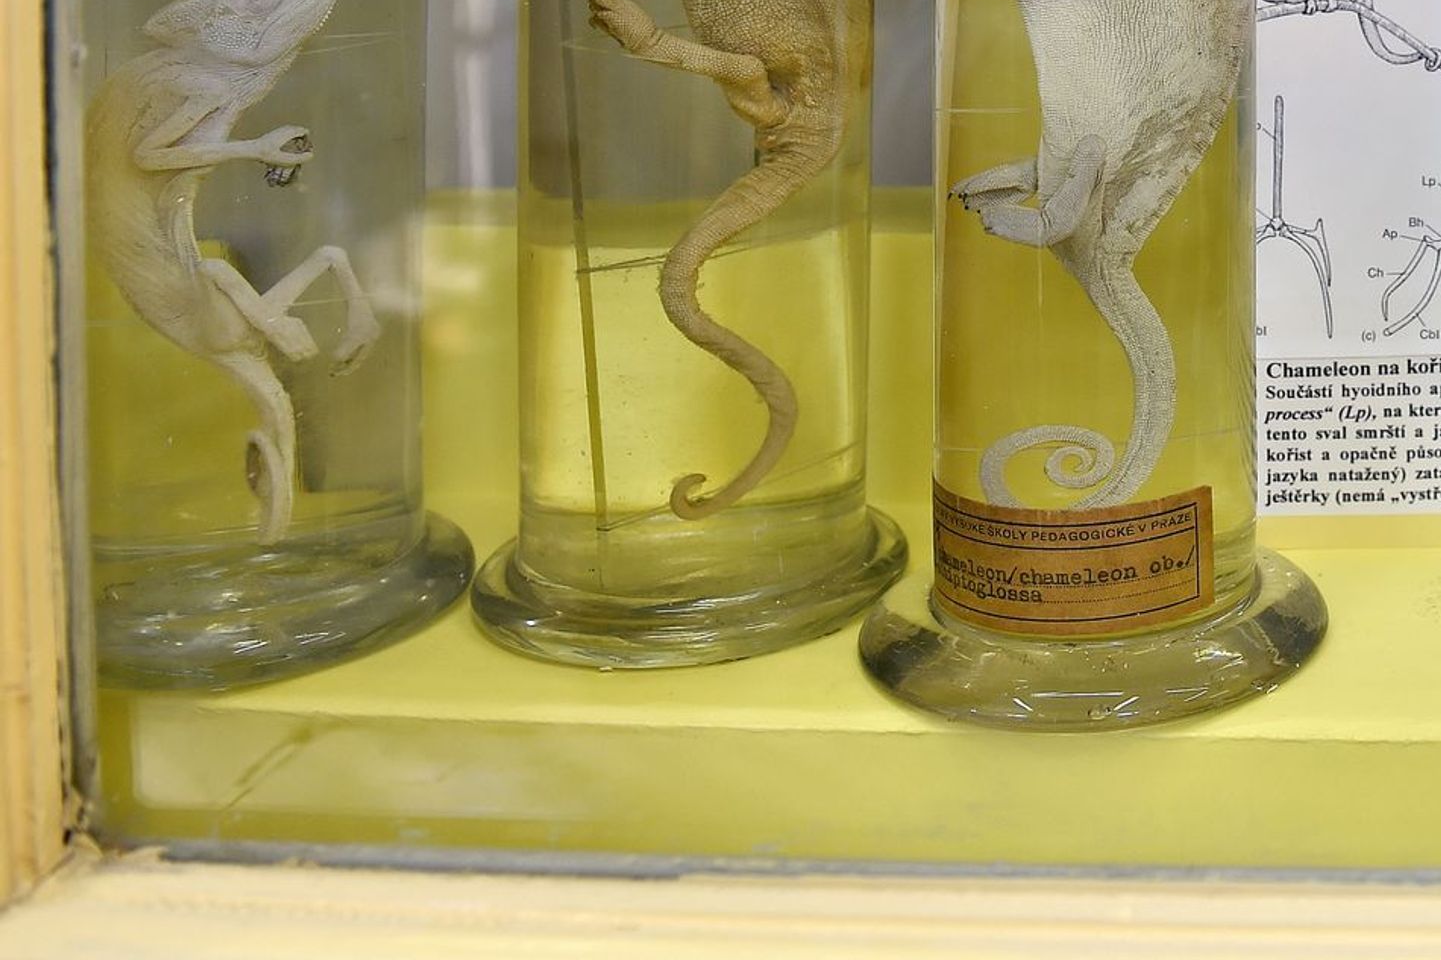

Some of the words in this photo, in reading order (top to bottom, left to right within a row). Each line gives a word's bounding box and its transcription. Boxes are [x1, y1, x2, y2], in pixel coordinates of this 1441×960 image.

[1421, 176, 1436, 187] Lp
[1409, 217, 1424, 227] Bh
[1382, 229, 1398, 240] Ap
[1367, 268, 1384, 278] Ch
[1361, 330, 1376, 342] (c)
[1267, 362, 1370, 378] Chameleon
[1378, 365, 1399, 375] na
[1266, 385, 1333, 399] Součástí
[1342, 382, 1421, 400] hyoidního
[1339, 405, 1377, 422] (Lp),
[1383, 408, 1402, 417] na
[1267, 428, 1306, 440] tento
[1315, 426, 1347, 440] sval
[1356, 426, 1405, 439] smrští
[1267, 448, 1312, 462] kořist
[1340, 447, 1397, 463] opačně
[1265, 469, 1318, 485] jazyka
[1329, 467, 1406, 483] natažený)
[1265, 490, 1329, 506] ještěrky
[1335, 488, 1384, 505] (nemá
[1031, 523, 1134, 541] PEDAGOGICKÉ
[1138, 523, 1147, 533] V
